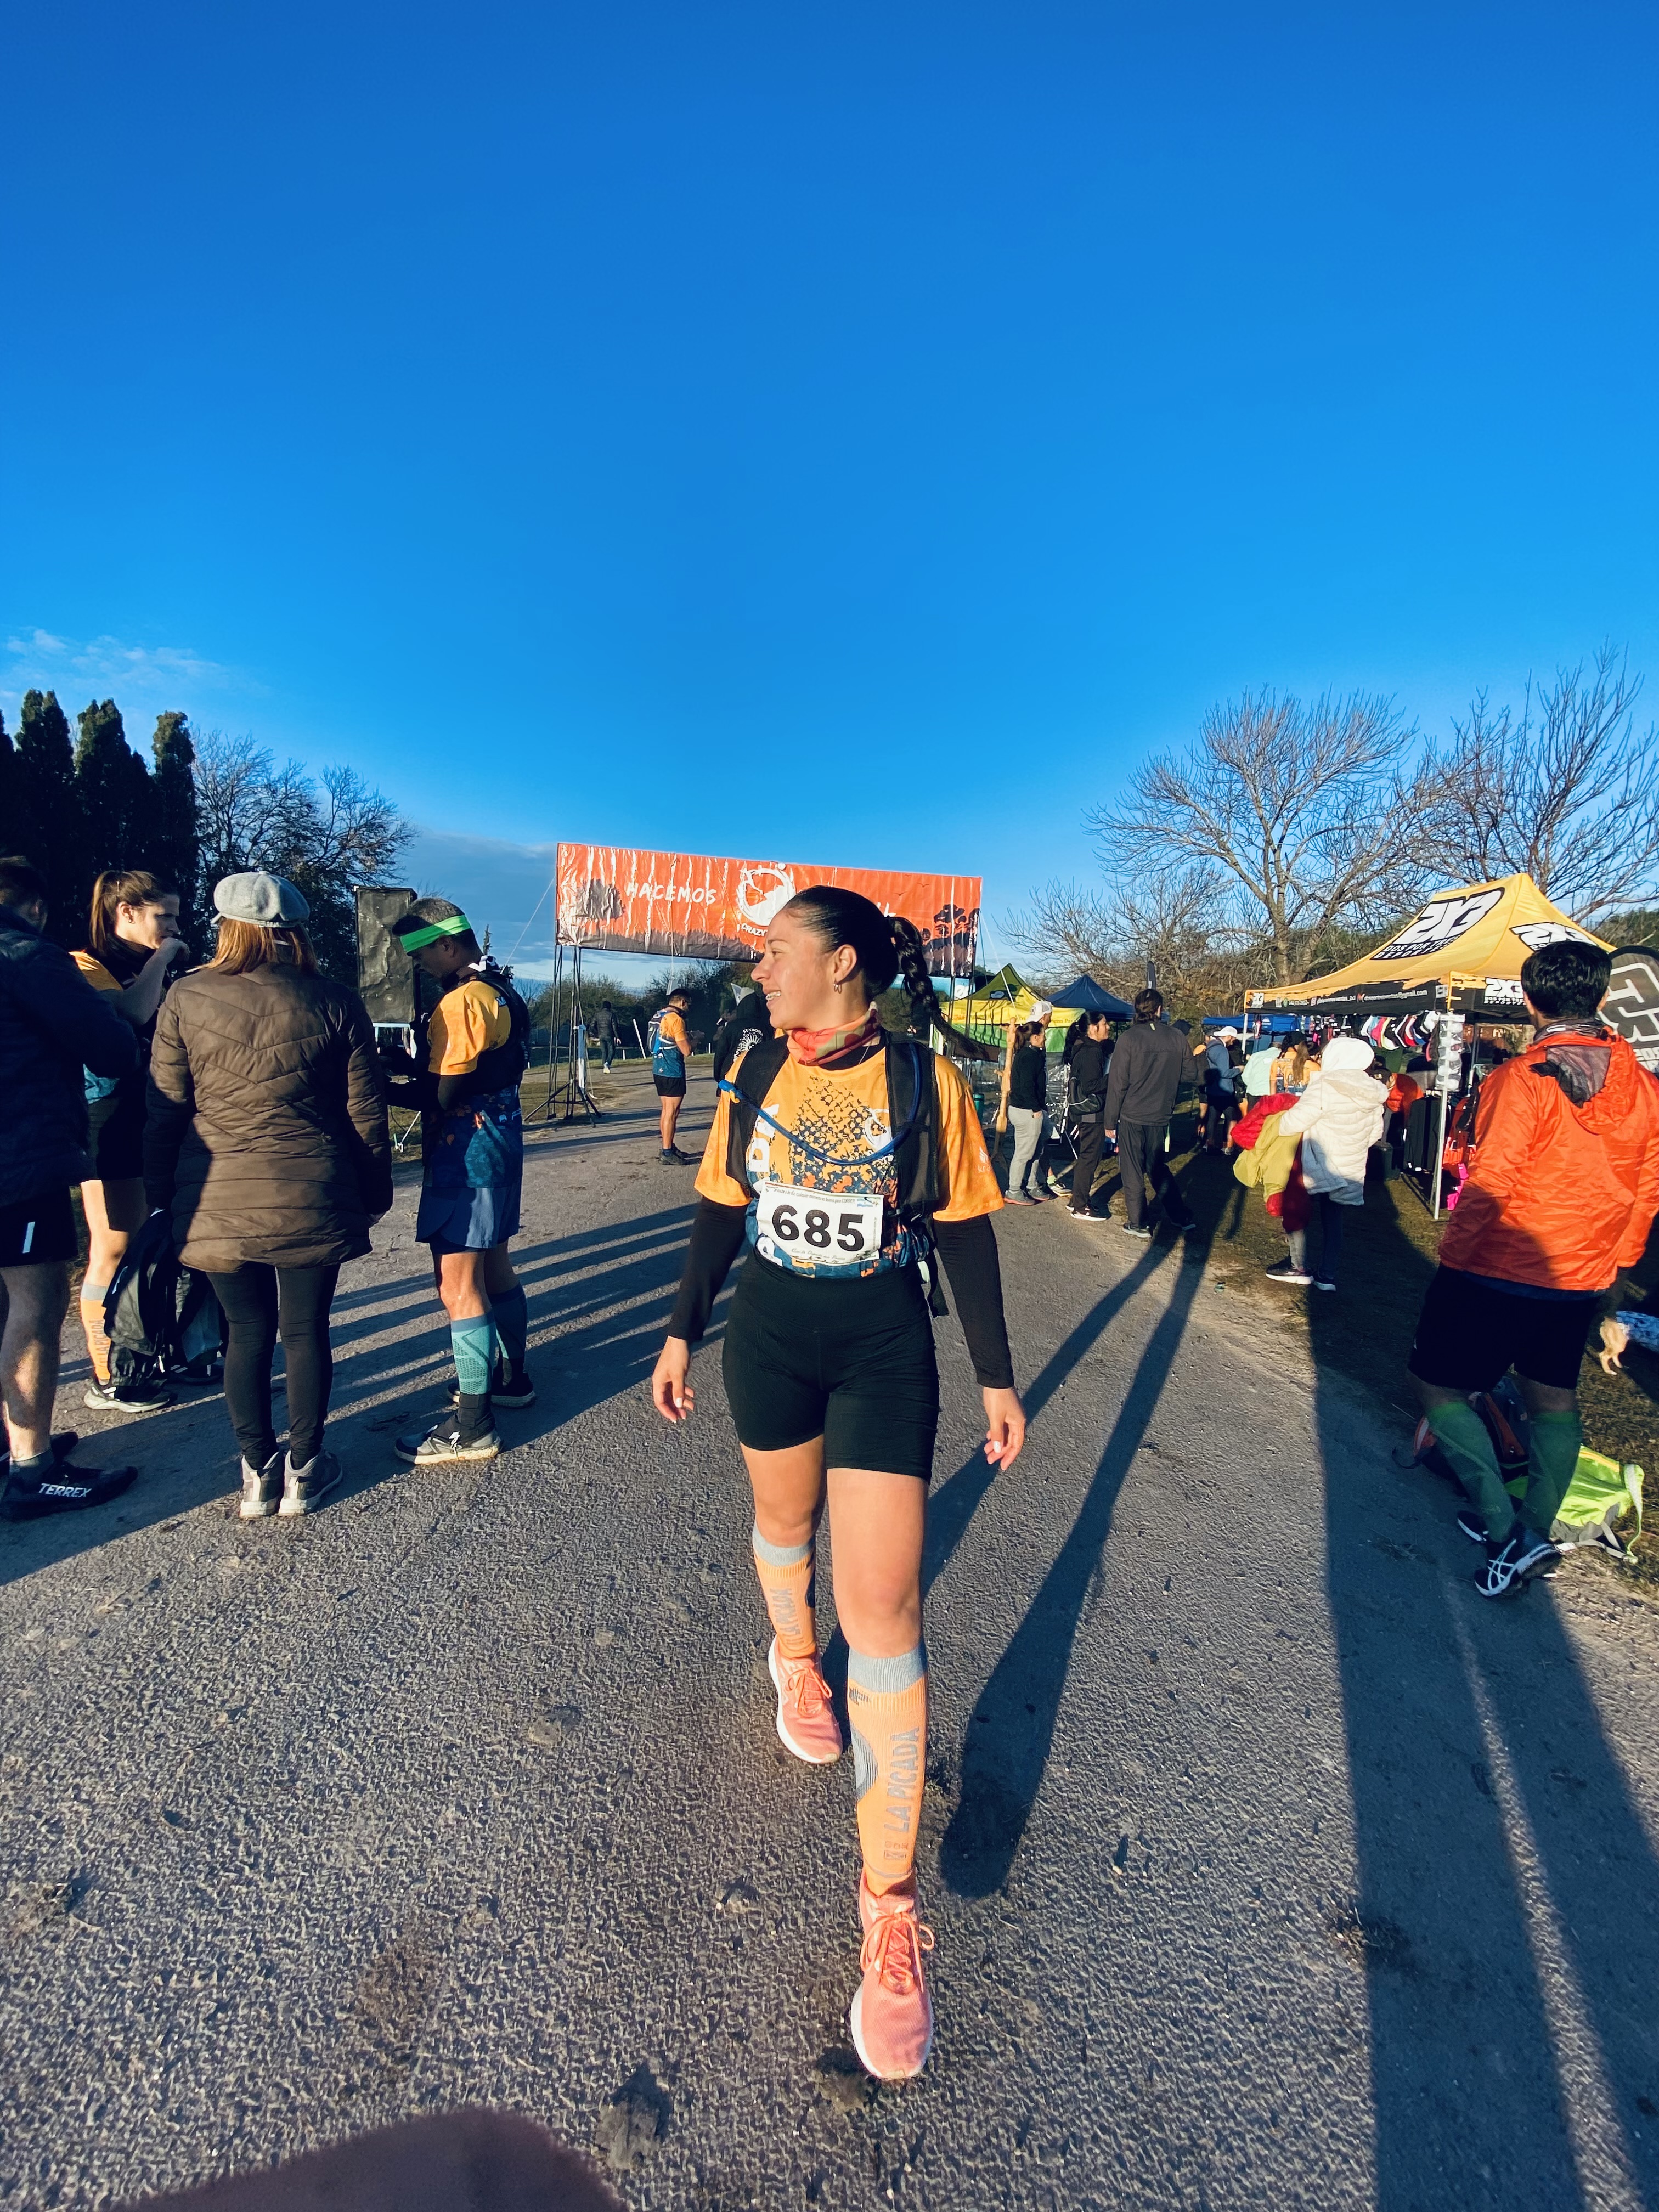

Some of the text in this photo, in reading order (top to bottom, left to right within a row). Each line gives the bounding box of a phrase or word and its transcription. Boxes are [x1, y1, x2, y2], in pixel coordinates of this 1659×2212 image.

[626, 881, 716, 905] HACEMOS
[1406, 943, 1431, 951] POR
[772, 1204, 865, 1252] 685
[39, 1483, 92, 1497] TERREX
[770, 1588, 799, 1624] PICADA
[887, 1727, 919, 1800] PICADA
[884, 1807, 911, 1833] LA
